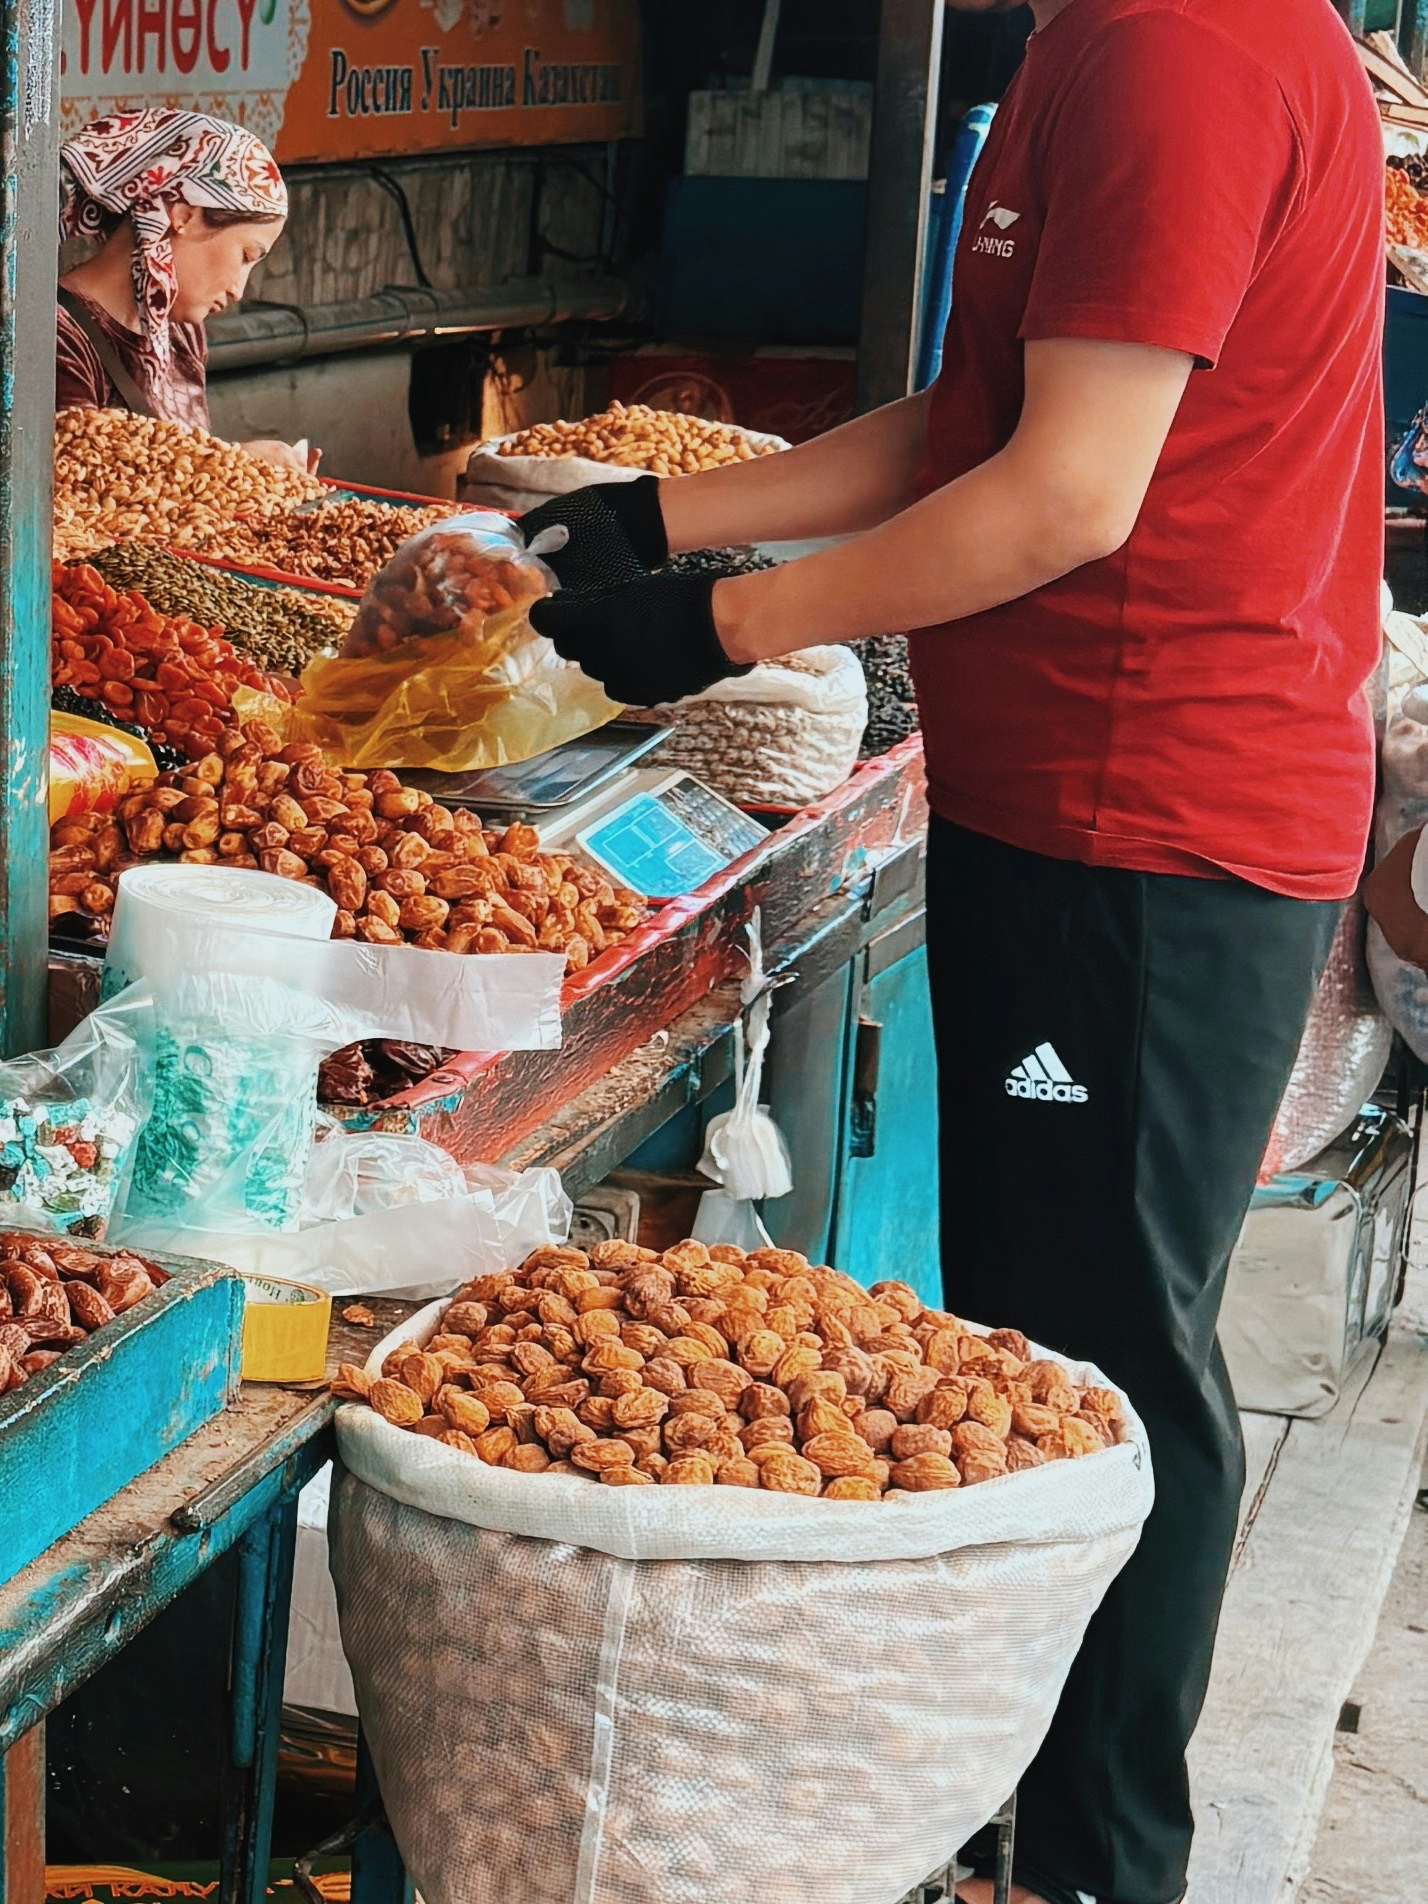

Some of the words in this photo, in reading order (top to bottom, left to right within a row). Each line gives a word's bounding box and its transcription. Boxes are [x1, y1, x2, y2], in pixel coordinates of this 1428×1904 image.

[327, 46, 414, 119] Россия
[420, 45, 516, 131] Украина
[1004, 1075, 1088, 1104] adidas
[110, 1881, 220, 1900] КАЛУ
